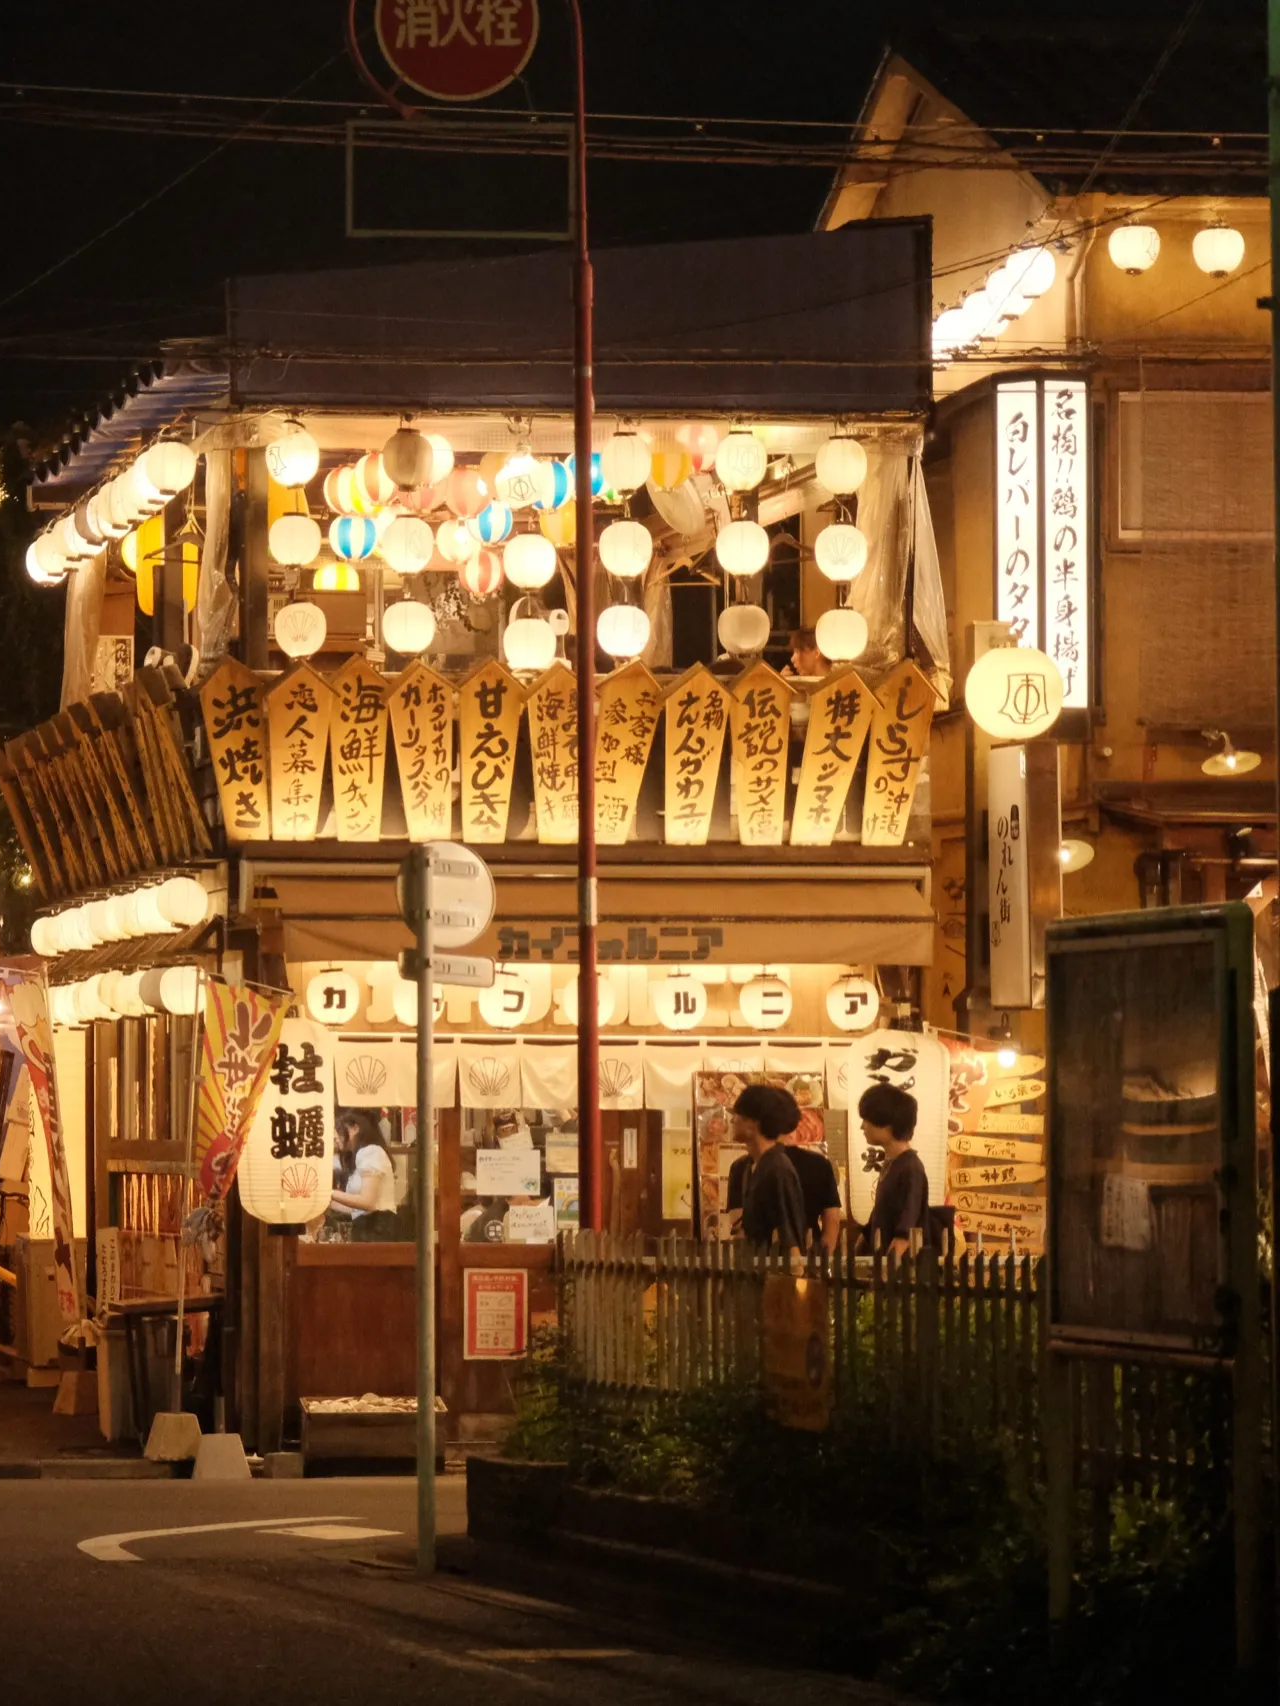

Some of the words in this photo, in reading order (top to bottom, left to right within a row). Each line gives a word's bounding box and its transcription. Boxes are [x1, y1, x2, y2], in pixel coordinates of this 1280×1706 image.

[393, 0, 524, 49] 消火栓
[1005, 411, 1032, 650] 白レバーのタタ
[212, 684, 265, 829] 浜焼き
[281, 682, 319, 831] 恋人募集中
[469, 679, 511, 838] 甘えびキム
[673, 690, 714, 833] えんがわユッ
[996, 815, 1015, 926] のれん街
[270, 1041, 326, 1160] 牡蠣
